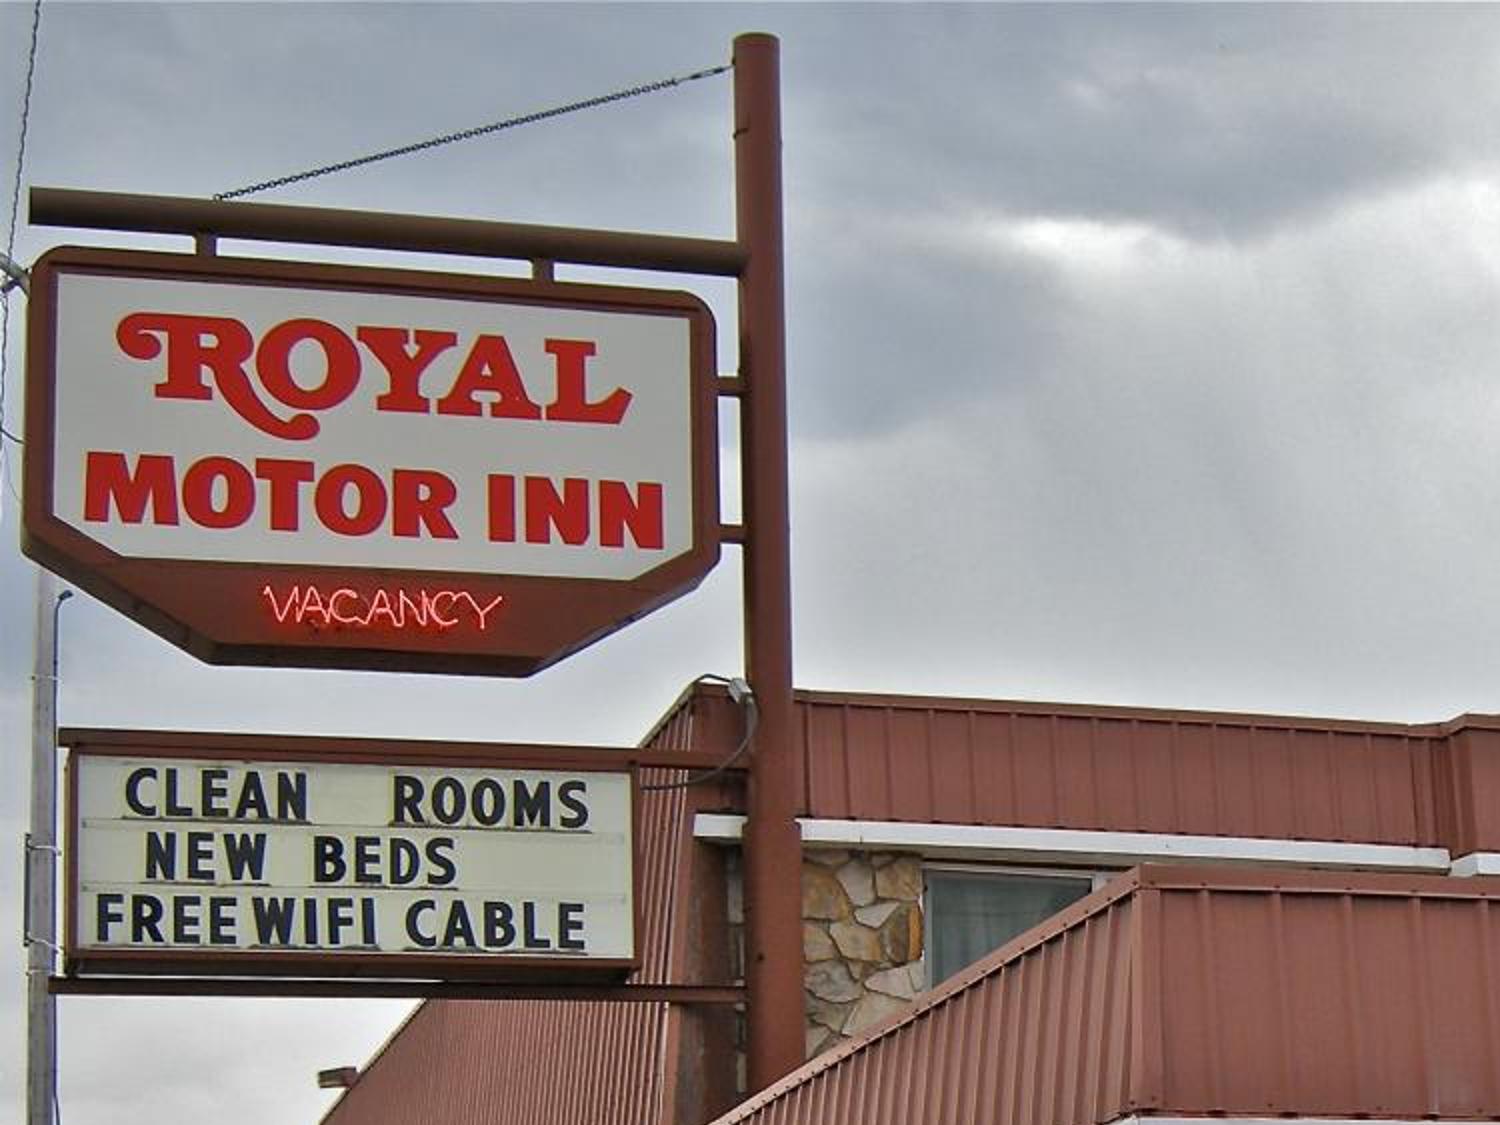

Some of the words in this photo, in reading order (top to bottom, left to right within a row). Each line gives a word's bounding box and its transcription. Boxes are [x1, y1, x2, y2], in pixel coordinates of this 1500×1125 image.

[115, 311, 634, 441] ROYAL
[84, 451, 459, 540] MOTOR
[488, 473, 665, 550] INN
[263, 585, 503, 630] VACANCY
[125, 767, 308, 821] CLEAN
[392, 774, 590, 828] ROOMS
[145, 831, 268, 882] NEW
[313, 835, 457, 885] BEDS
[97, 893, 239, 945] FREE
[253, 896, 376, 947] WIFI
[404, 899, 586, 950] CABLE
